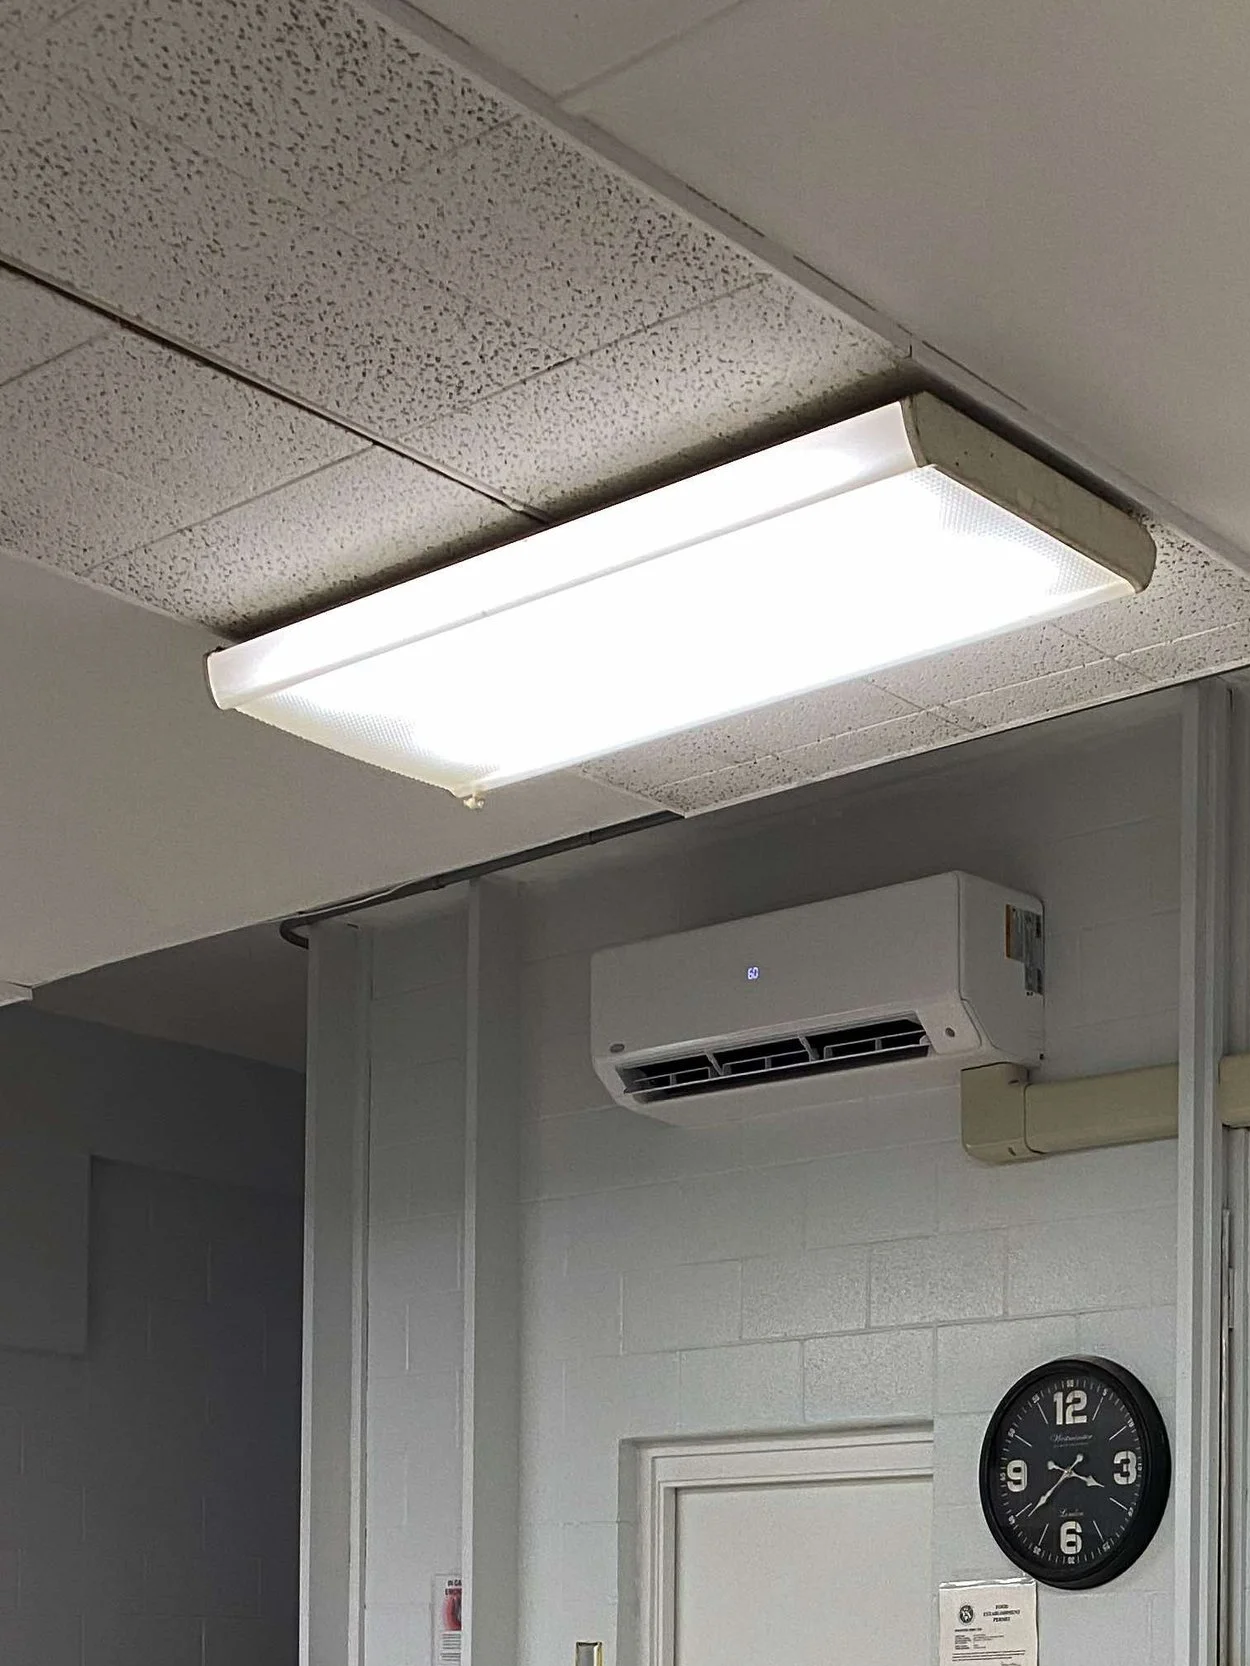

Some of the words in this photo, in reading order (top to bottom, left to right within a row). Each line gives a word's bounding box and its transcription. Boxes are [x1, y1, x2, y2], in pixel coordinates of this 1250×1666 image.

[1053, 1390, 1088, 1426] 12
[1006, 1459, 1028, 1493] 9
[1113, 1450, 1138, 1485] 3
[1060, 1520, 1083, 1555] 6
